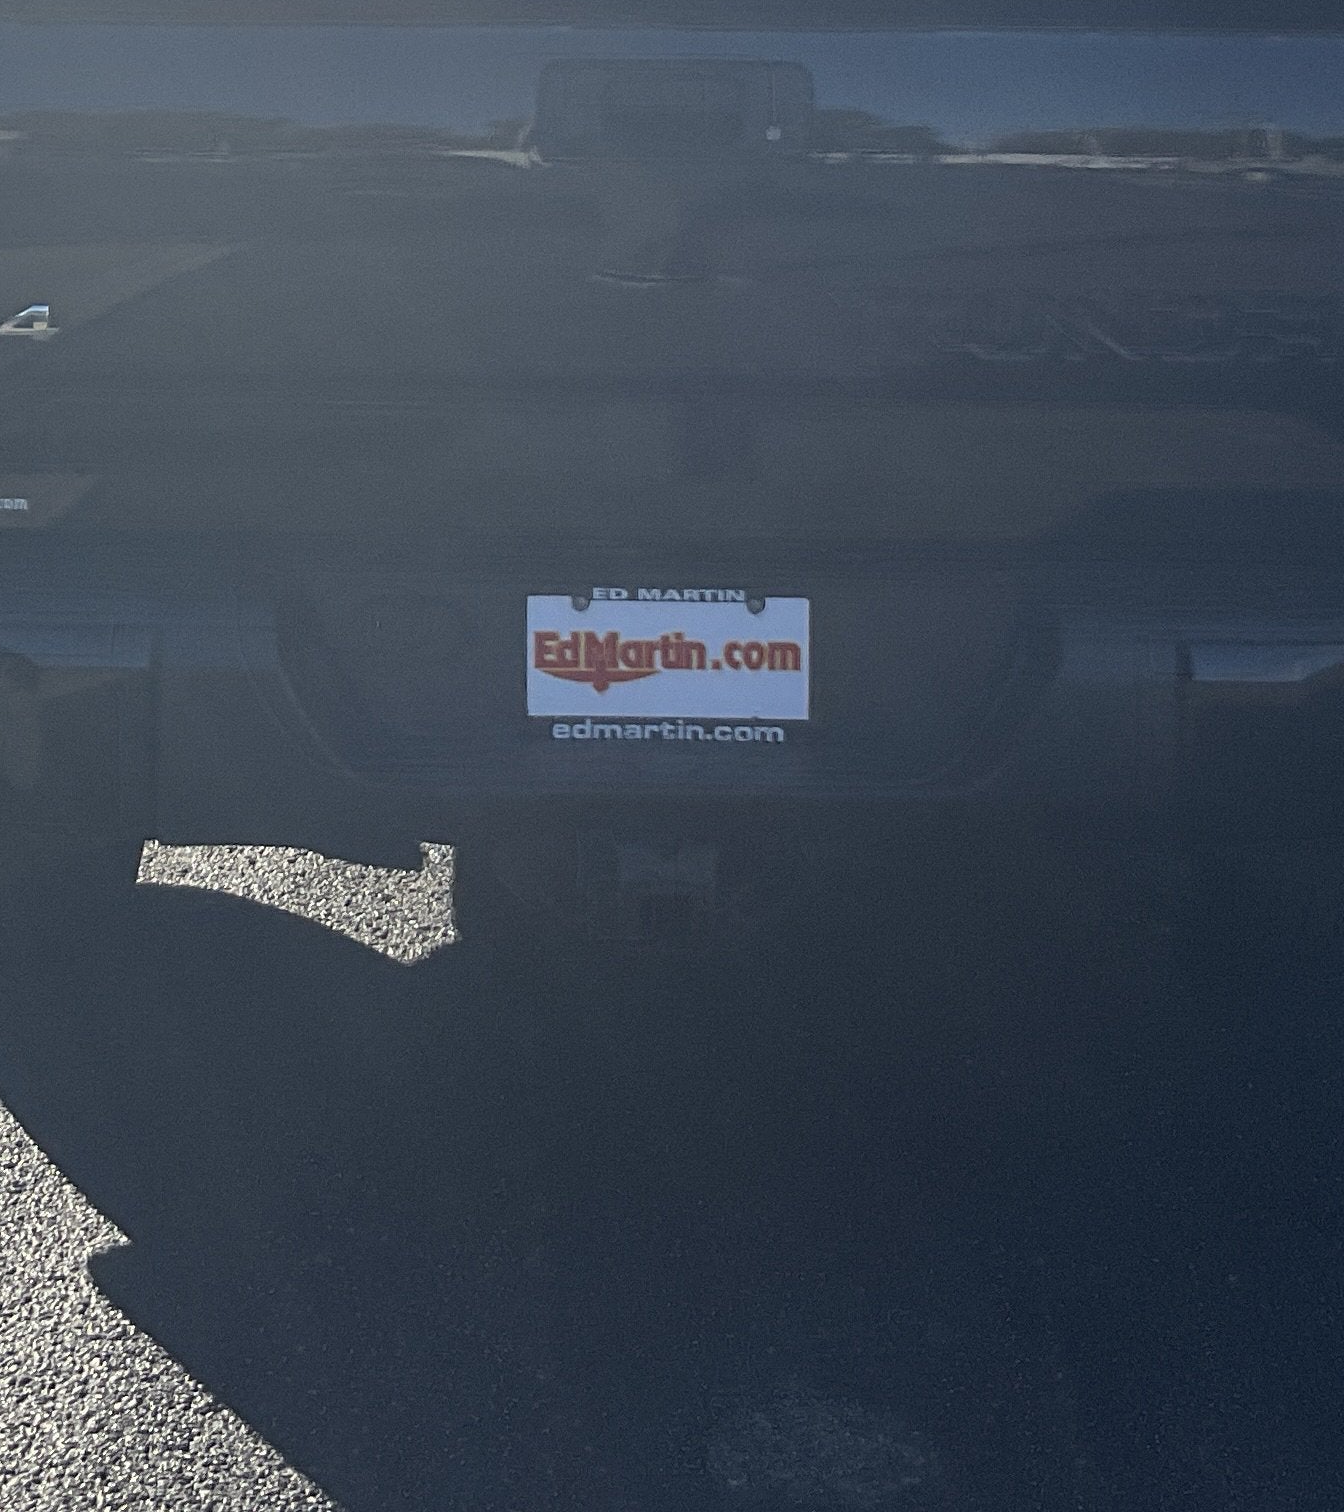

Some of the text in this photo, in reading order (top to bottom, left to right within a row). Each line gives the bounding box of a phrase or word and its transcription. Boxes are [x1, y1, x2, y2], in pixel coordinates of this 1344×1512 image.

[592, 587, 746, 602] ED MARTIN
[552, 718, 786, 743] edmartin.com
